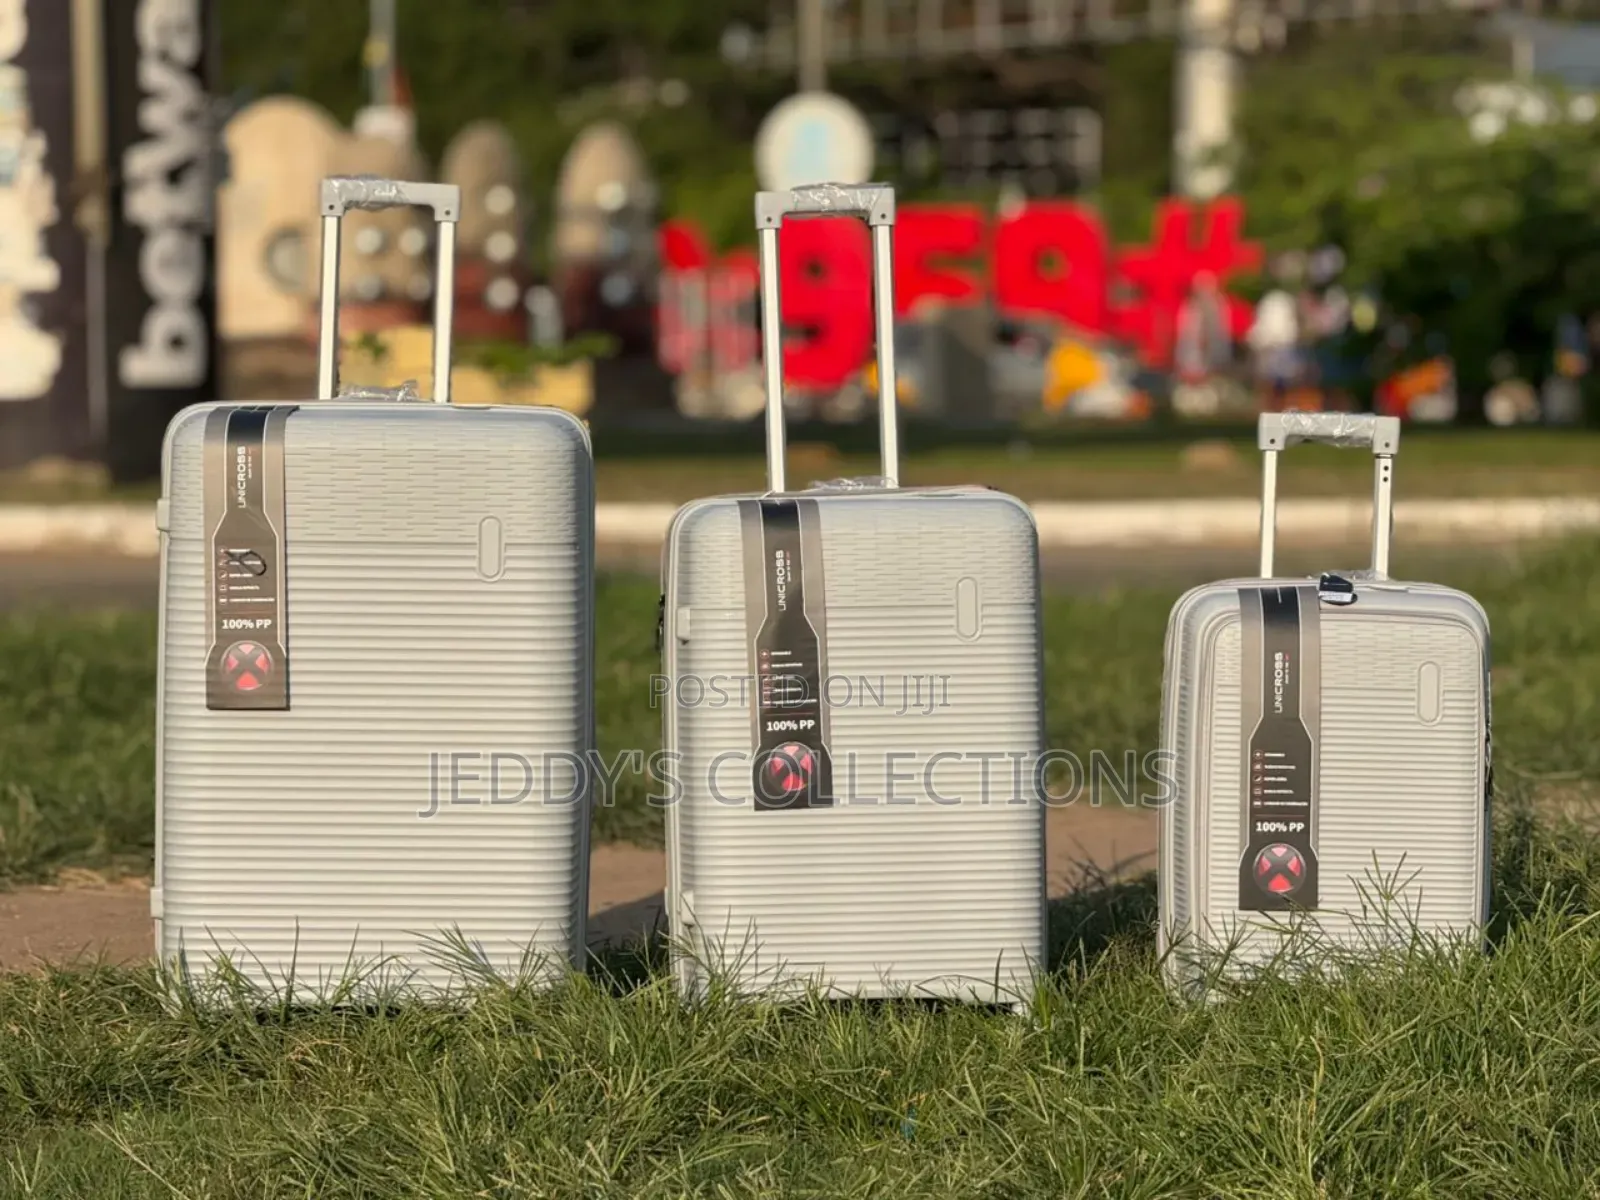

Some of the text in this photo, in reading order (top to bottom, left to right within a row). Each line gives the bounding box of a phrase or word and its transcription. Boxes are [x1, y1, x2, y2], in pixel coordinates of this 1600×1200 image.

[236, 445, 246, 509] UNICROSS
[775, 549, 786, 612] UNICROSS
[221, 618, 272, 630] 100% PP
[1274, 652, 1284, 714] UNICROSS
[766, 719, 815, 732] 100% PP
[1255, 821, 1304, 832] 100% PP
